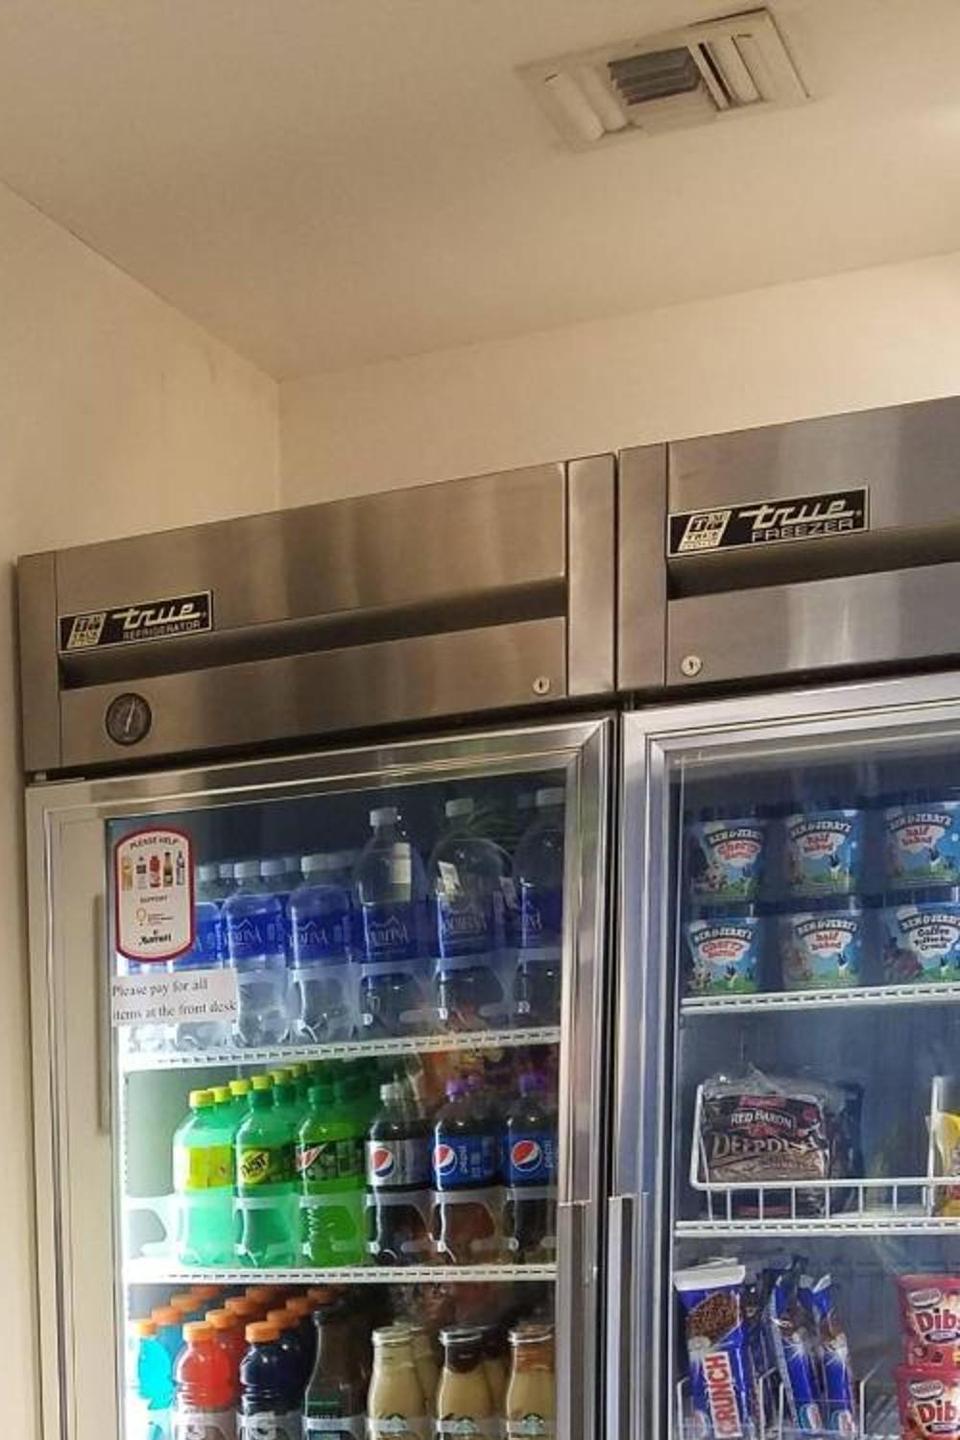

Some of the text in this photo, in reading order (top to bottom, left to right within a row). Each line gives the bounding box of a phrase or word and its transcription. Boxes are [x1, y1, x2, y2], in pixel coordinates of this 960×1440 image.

[752, 518, 854, 542] FREEZER
[122, 621, 201, 640] REFRIGERATOR
[130, 836, 157, 849] PLEASE
[149, 984, 169, 997] pay
[172, 979, 189, 992] for
[192, 977, 208, 990] all
[178, 1002, 207, 1016] front
[210, 998, 237, 1013] desk
[705, 1354, 738, 1437] CRUNCH
